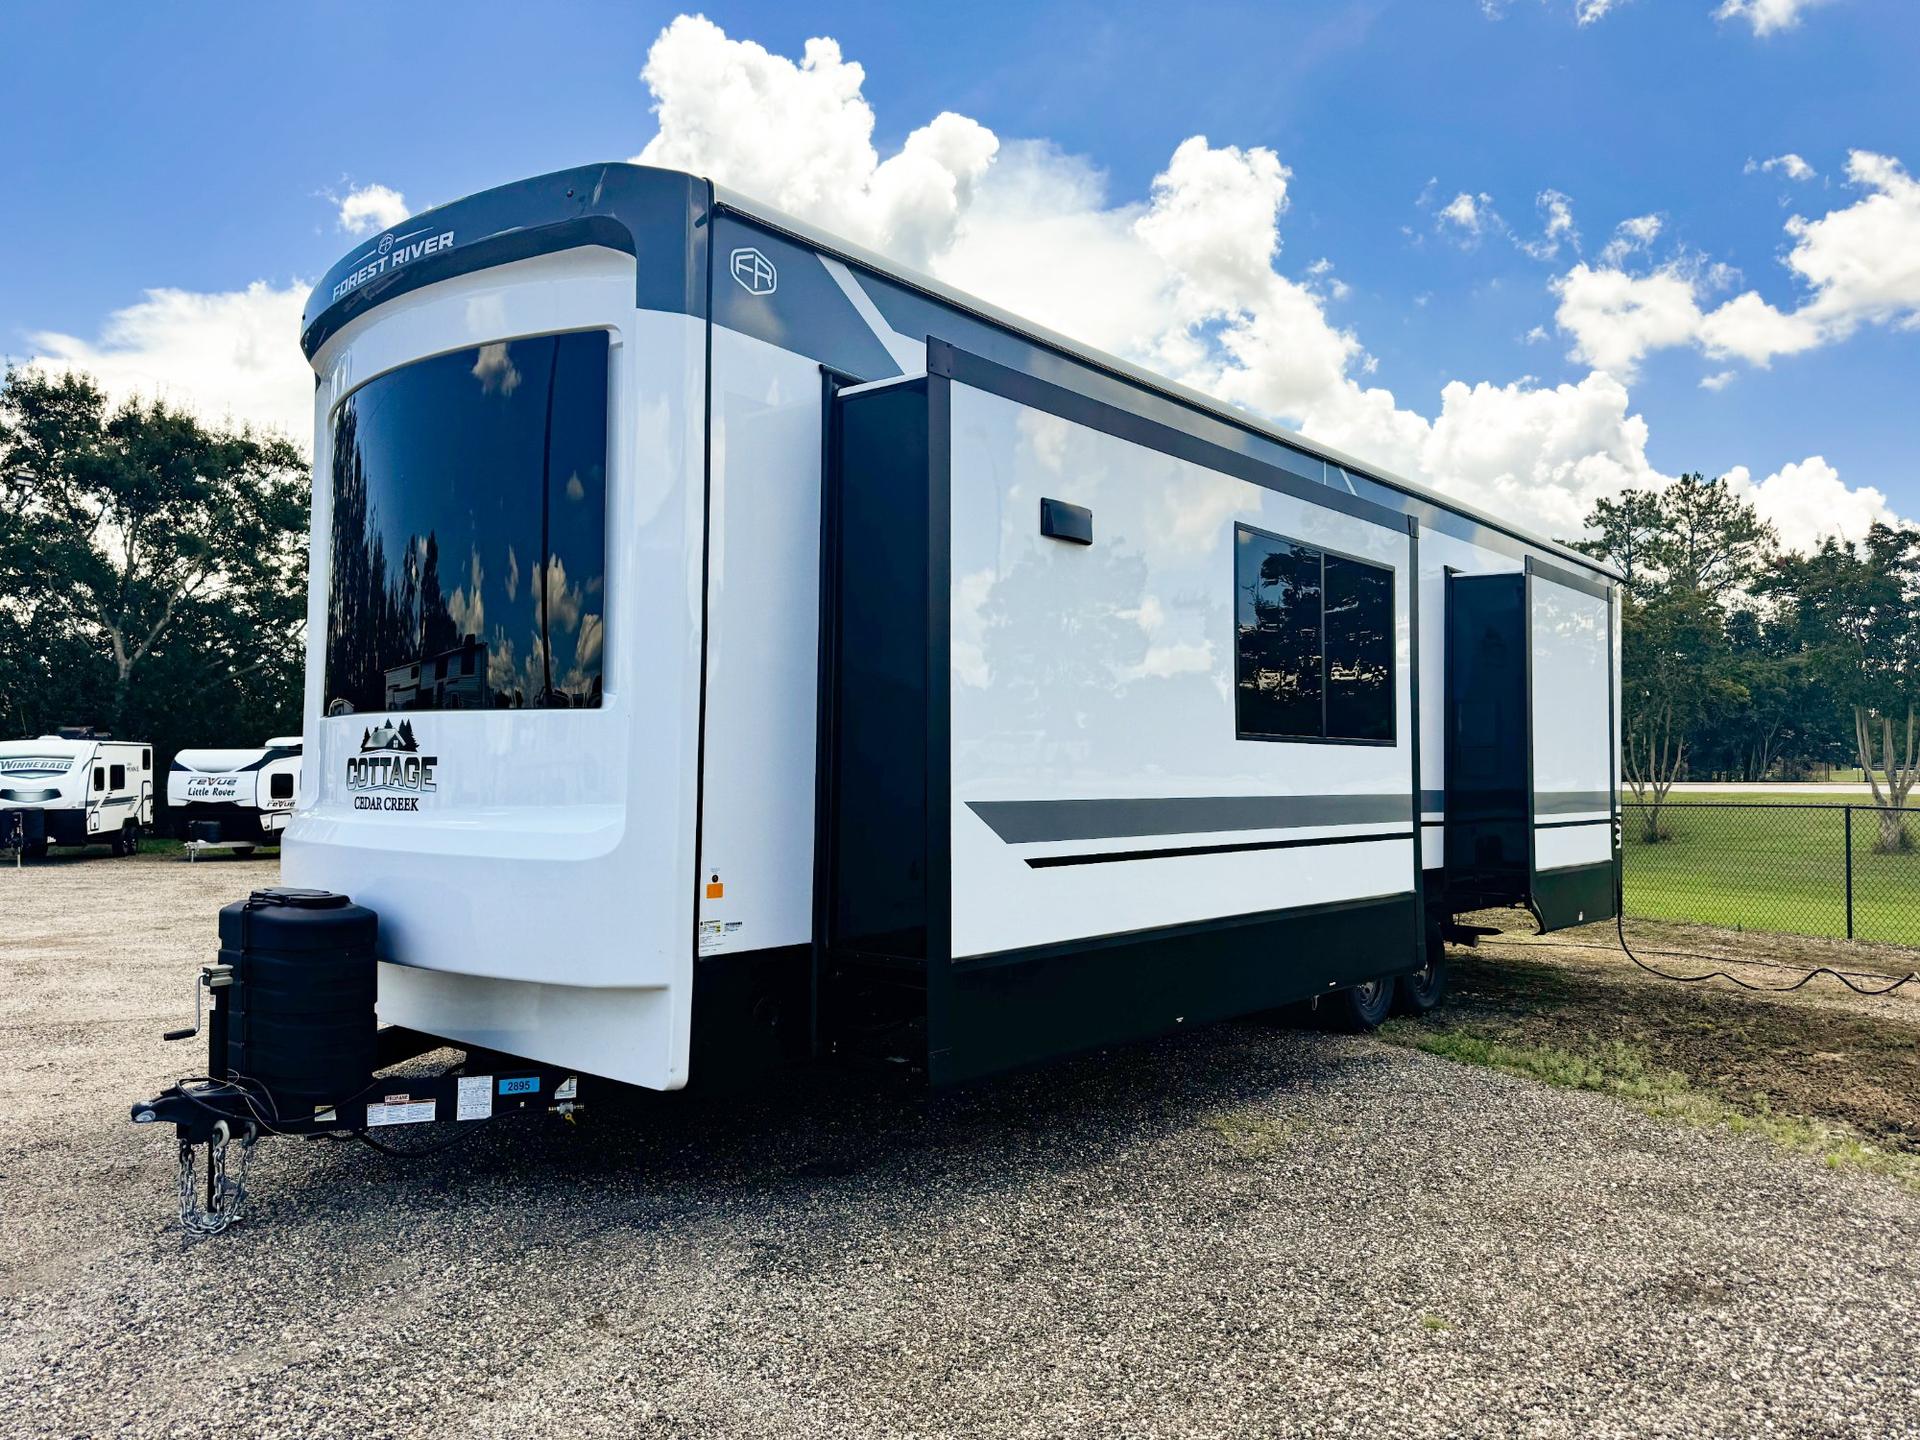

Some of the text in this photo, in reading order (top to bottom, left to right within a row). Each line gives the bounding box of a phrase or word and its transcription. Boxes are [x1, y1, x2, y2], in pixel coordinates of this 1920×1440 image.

[332, 231, 454, 301] FOREST RIVER
[346, 756, 438, 792] COTTAGE
[188, 787, 235, 796] Little Rover
[354, 796, 419, 811] CEDAR CREEK
[507, 1081, 530, 1091] 2895
